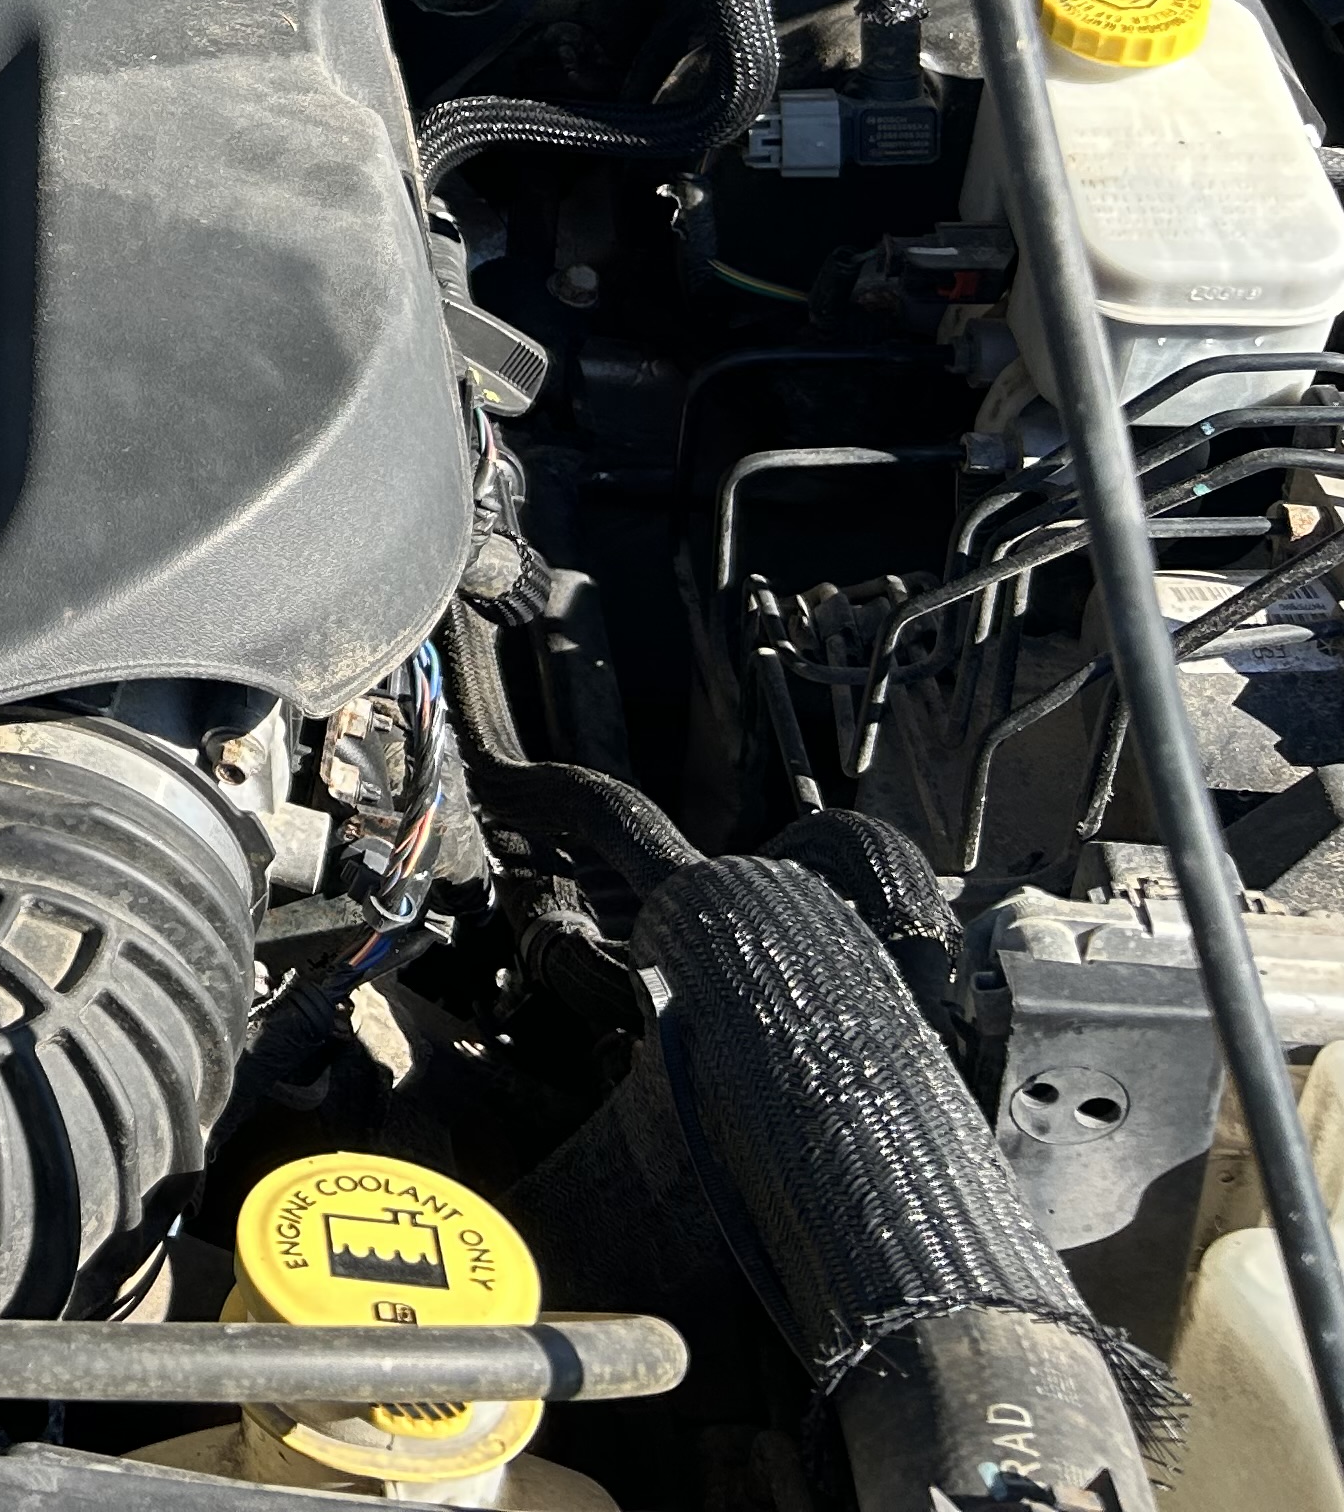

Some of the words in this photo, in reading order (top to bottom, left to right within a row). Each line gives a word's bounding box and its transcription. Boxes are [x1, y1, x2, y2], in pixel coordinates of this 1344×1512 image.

[276, 1190, 318, 1271] ENGINE
[315, 1174, 464, 1223] COOLANT
[458, 1228, 497, 1292] ONLY
